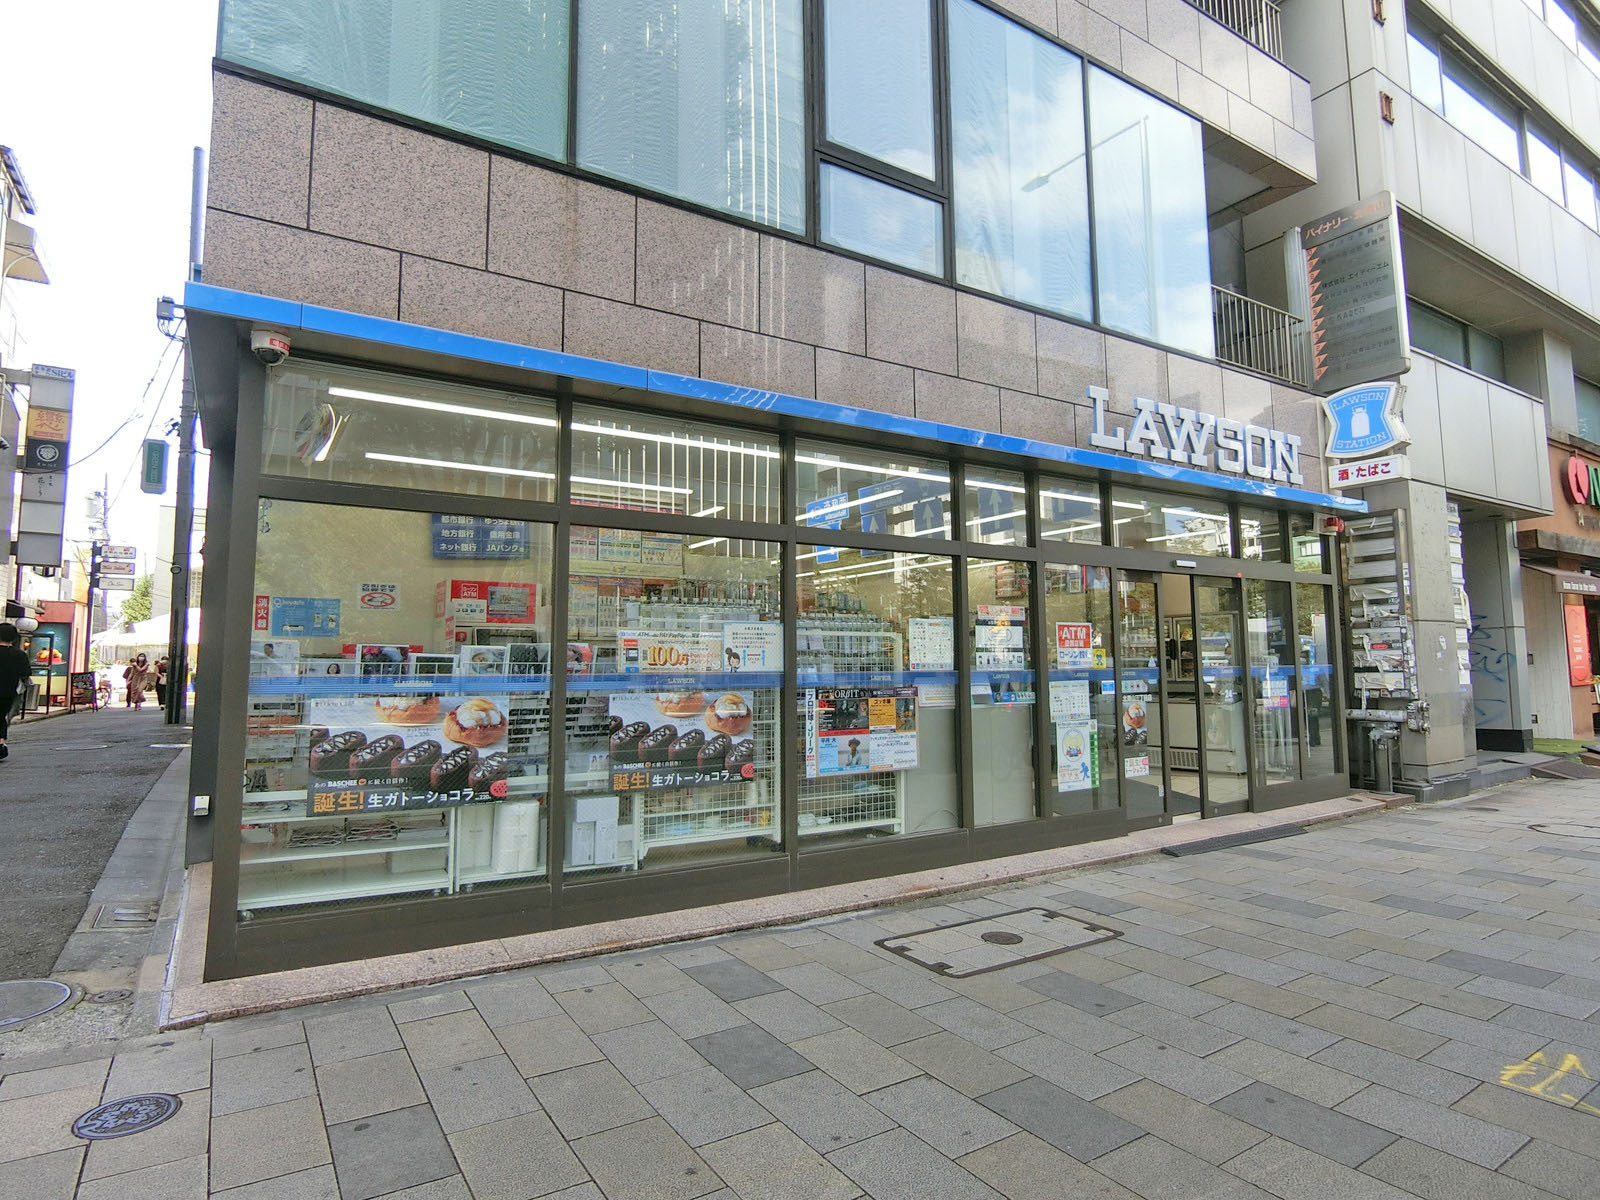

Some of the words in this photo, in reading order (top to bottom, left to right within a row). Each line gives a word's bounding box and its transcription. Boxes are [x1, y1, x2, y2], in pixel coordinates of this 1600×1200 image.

[1333, 391, 1386, 411] LAWSON
[1086, 385, 1304, 485] LAWSON
[1336, 432, 1387, 449] STATION
[1338, 462, 1391, 481] 酒・たばこ
[441, 529, 474, 538] 地方銀行
[440, 543, 477, 552] ネット銀行
[1062, 627, 1086, 639] ATM
[1059, 651, 1092, 659] ローソン銀
[613, 772, 650, 791] 誕生!
[652, 770, 729, 787] 生ガトーショコラ
[313, 791, 365, 813] 誕生!
[367, 788, 475, 809] 生ガトーショコラ
